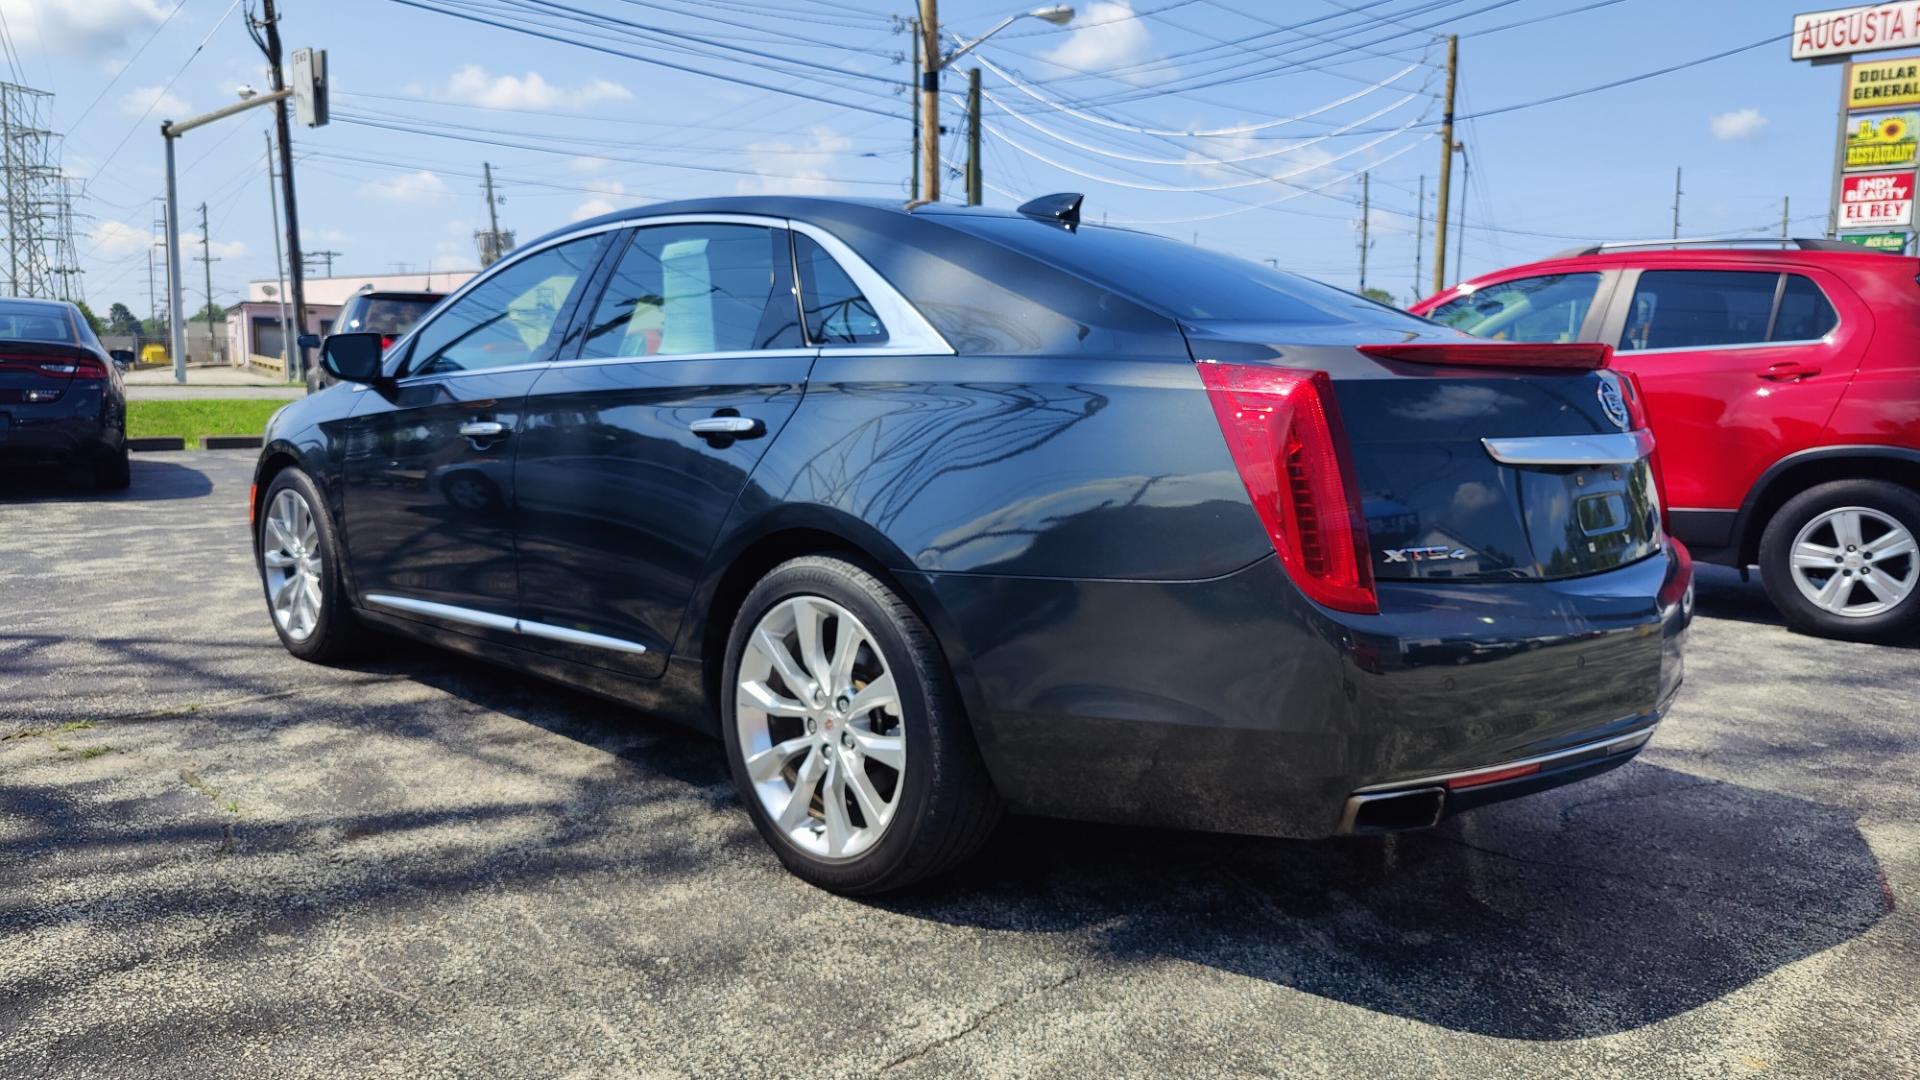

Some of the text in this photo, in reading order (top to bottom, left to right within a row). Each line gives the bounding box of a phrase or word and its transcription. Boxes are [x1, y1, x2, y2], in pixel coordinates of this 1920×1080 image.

[1798, 8, 1905, 50] AUGUSTA
[1859, 66, 1917, 82] DOLLAR
[1853, 82, 1920, 100] GENERAL
[1848, 143, 1916, 164] RESTAURANT
[1857, 176, 1898, 190] INDY
[1845, 187, 1908, 202] BEAUTY
[1847, 203, 1904, 218] EL REY
